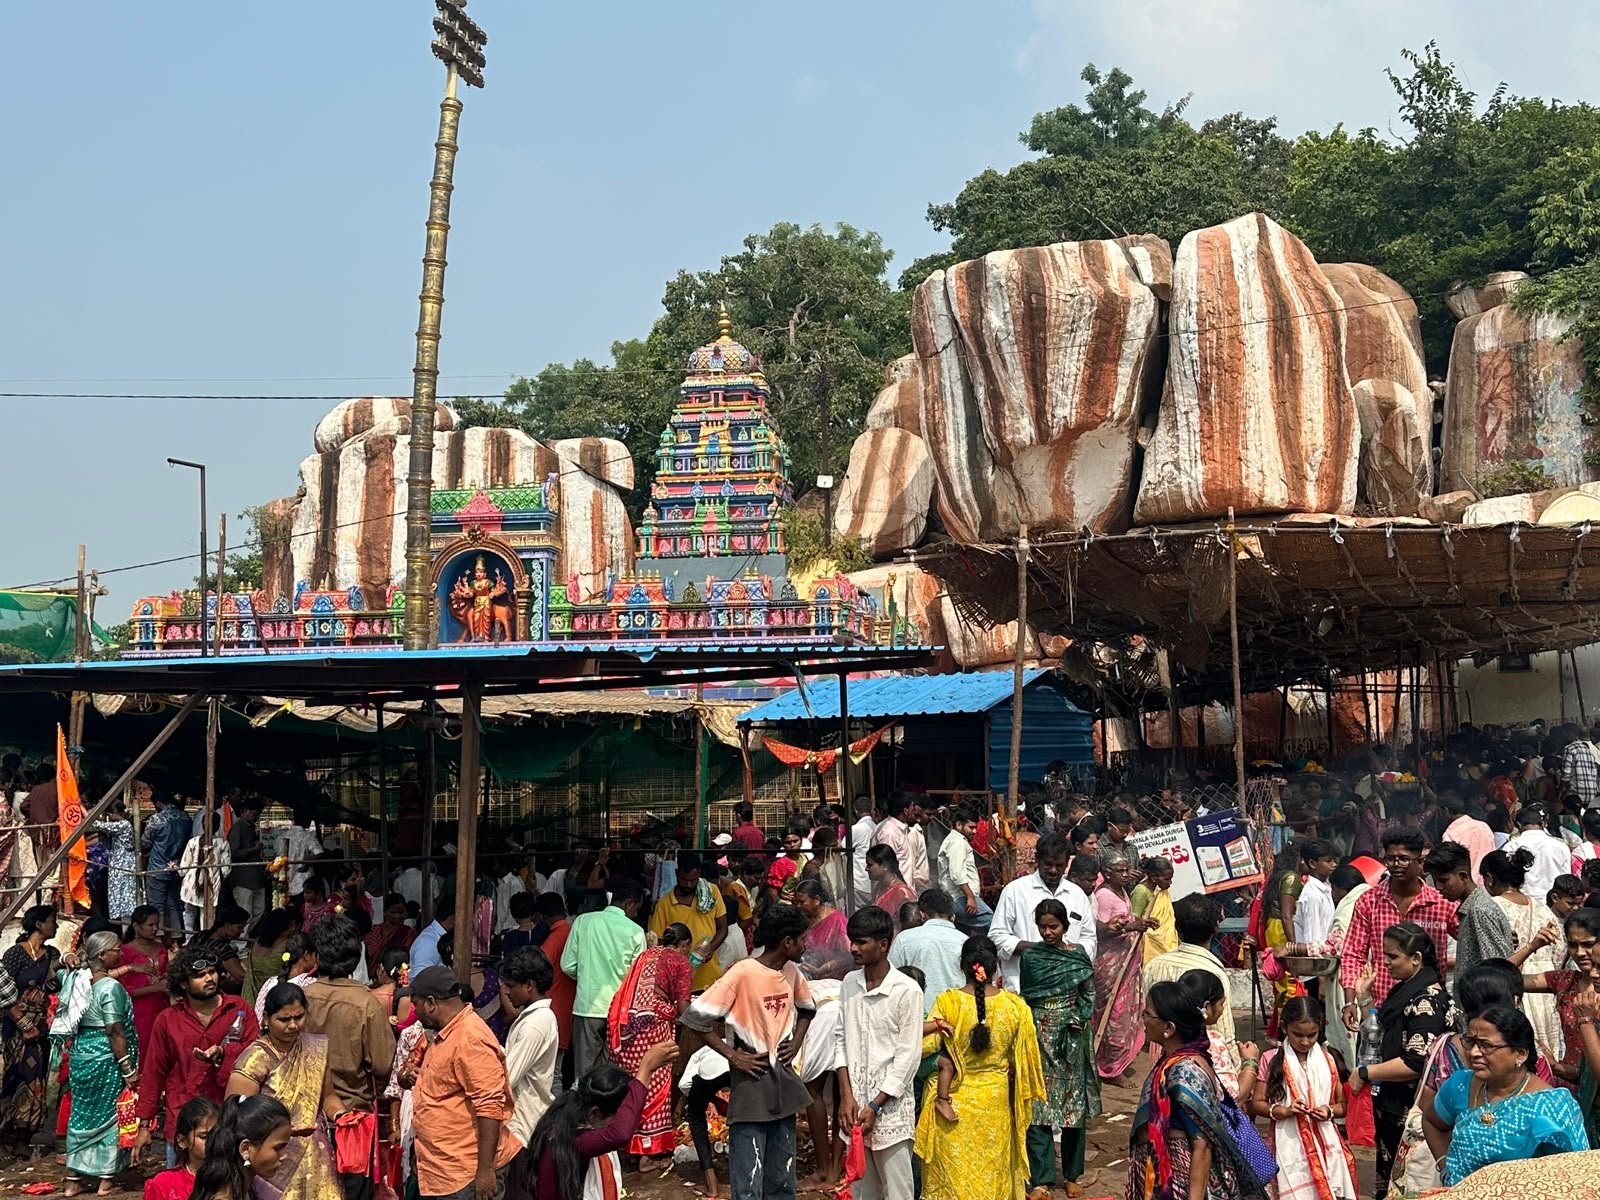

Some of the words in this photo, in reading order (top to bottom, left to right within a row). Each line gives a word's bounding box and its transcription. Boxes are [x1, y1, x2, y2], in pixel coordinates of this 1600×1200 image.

[1149, 831, 1165, 840] VANA
[1165, 827, 1184, 836] DURGA
[1144, 836, 1177, 848] DEVALAYAM
